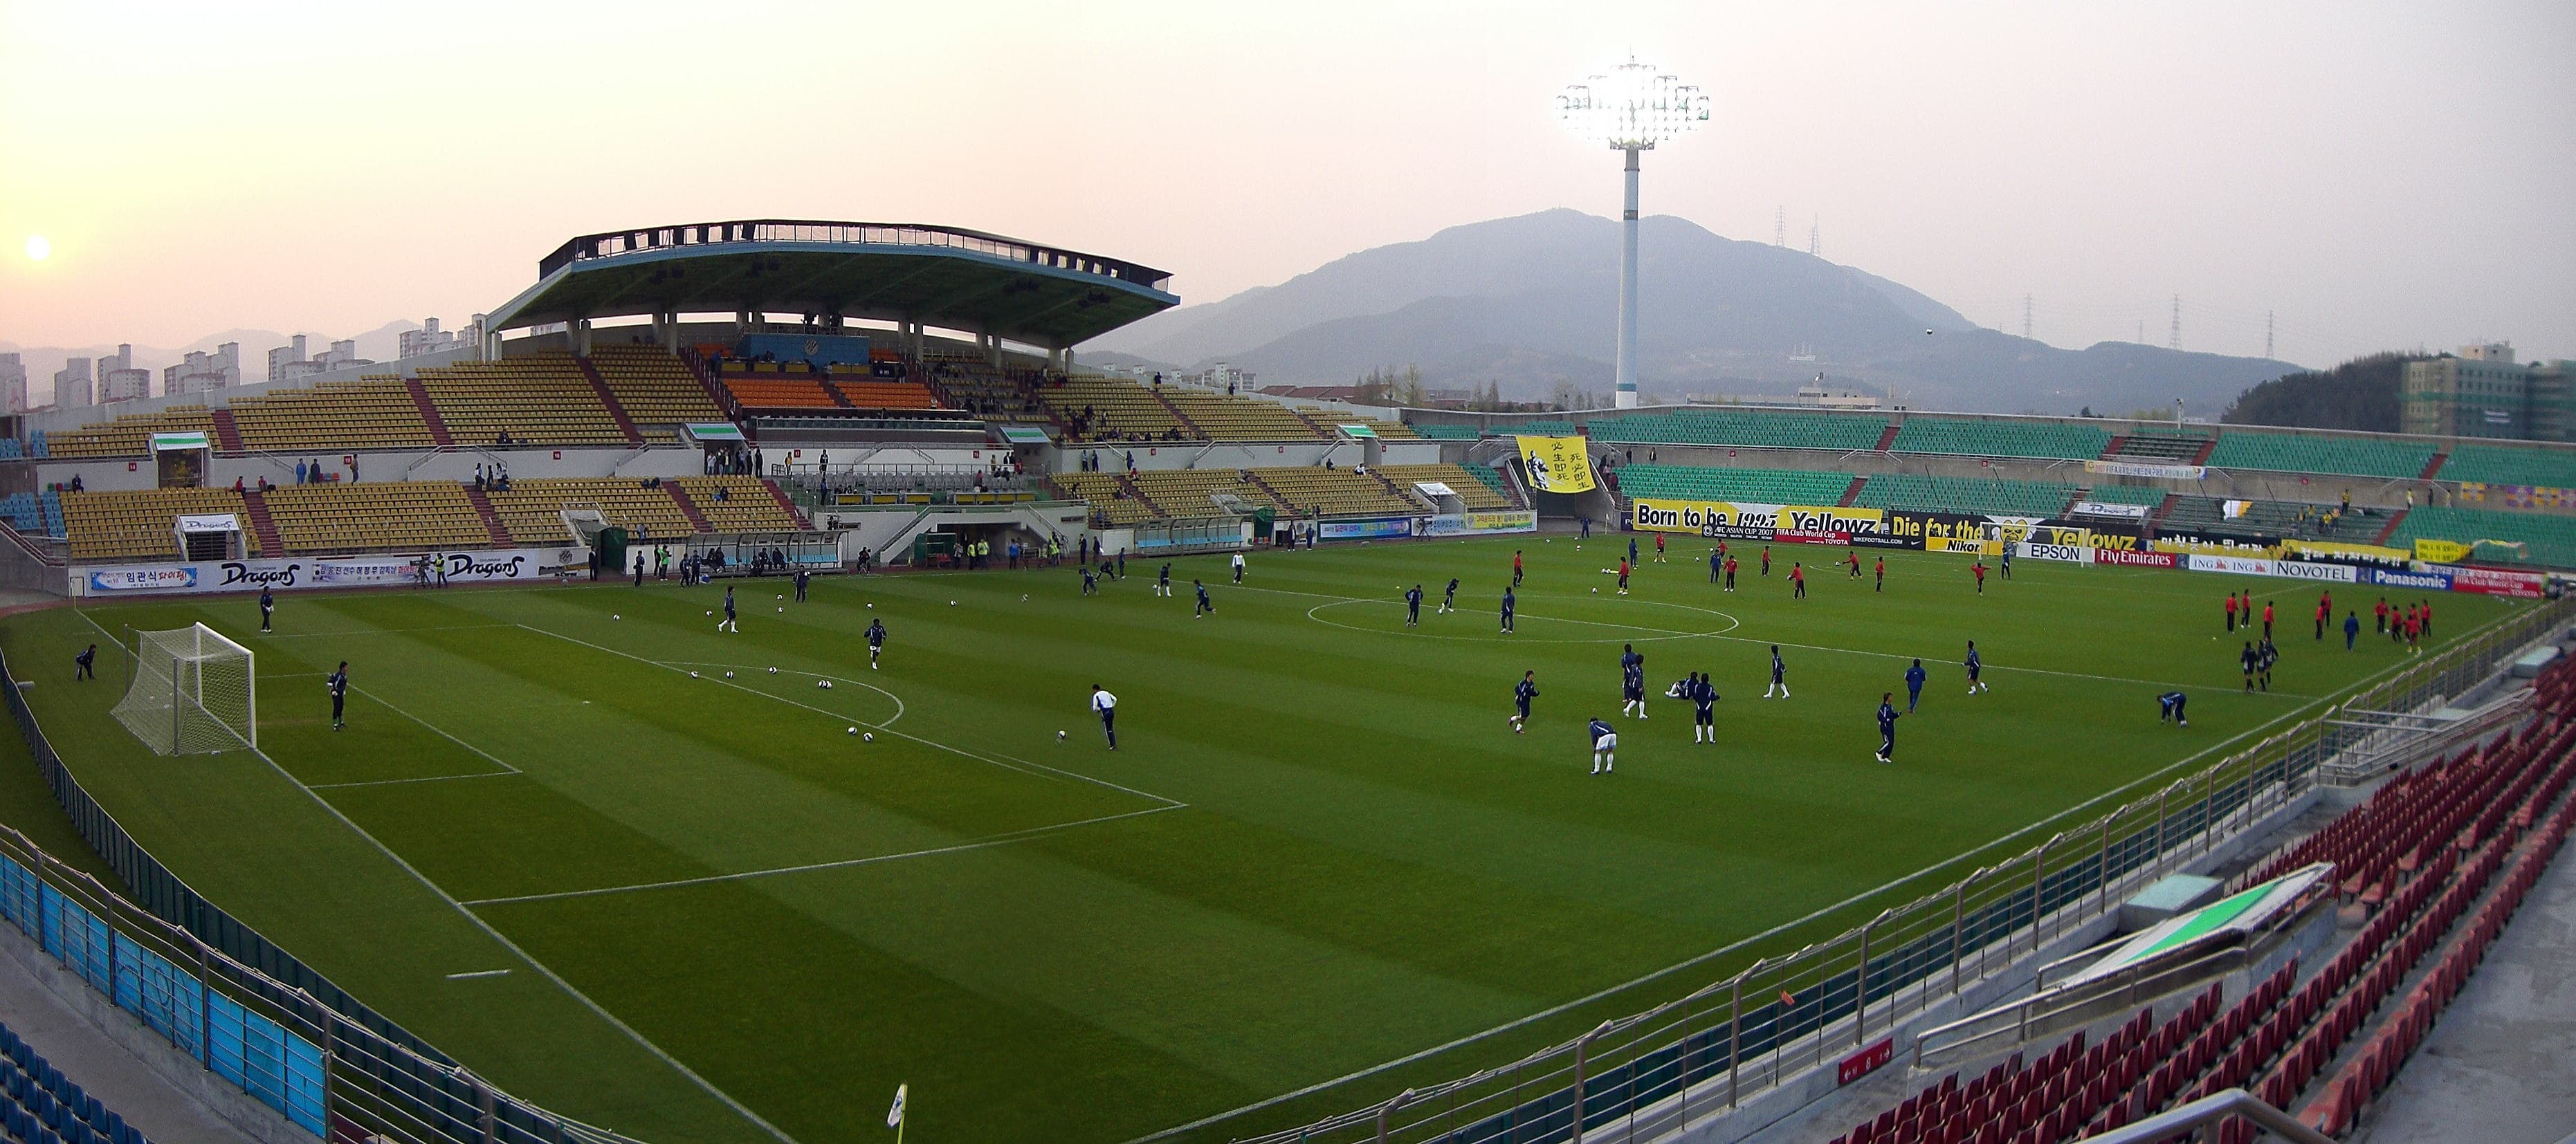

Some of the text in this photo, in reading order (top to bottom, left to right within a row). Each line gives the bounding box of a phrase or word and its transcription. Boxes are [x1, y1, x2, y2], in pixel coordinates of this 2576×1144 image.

[1638, 504, 1877, 533] Born to be 1995 Yellowz
[1790, 528, 1804, 537] Club
[1805, 530, 1823, 538] World
[1824, 531, 1836, 539] Cup
[1892, 516, 2137, 551] Die for the Yellowz
[1947, 540, 1981, 553] Nikon
[2031, 545, 2080, 560] EPSON
[2101, 548, 2171, 565] Fly Emirates
[447, 554, 525, 578] Dragons
[2195, 559, 2253, 571] ING ING
[2277, 562, 2350, 580] NOVOTEL
[126, 571, 158, 582] 임관식
[220, 562, 301, 587] Dragons
[2376, 569, 2447, 588] Panasonic
[2455, 576, 2524, 589] FIFA Club World Cup
[2510, 589, 2539, 598] TOYOTA
[1865, 1056, 1871, 1071] 8
